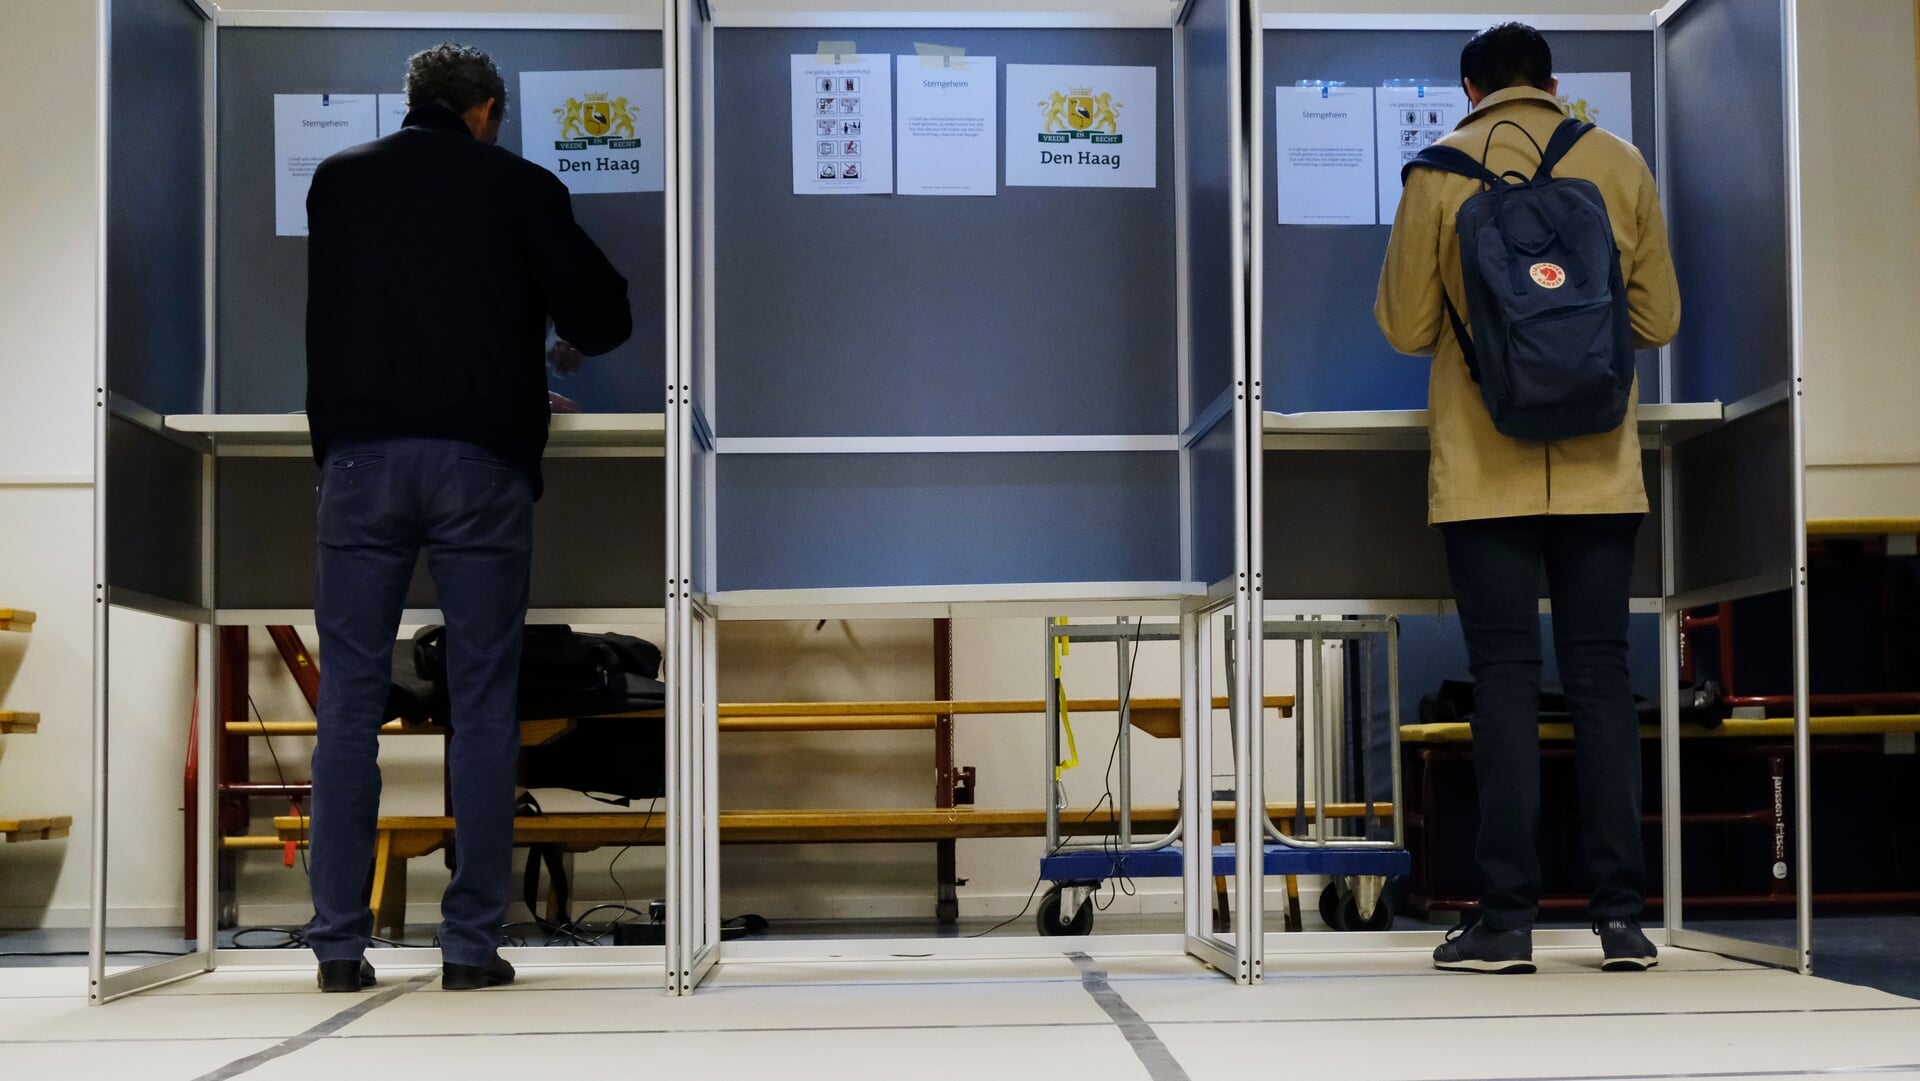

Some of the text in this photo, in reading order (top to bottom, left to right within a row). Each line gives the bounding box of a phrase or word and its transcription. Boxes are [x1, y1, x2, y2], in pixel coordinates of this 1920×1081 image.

[922, 80, 969, 89] Stemgeheim
[1302, 111, 1347, 120] Stemgeheim
[301, 119, 349, 128] Stemgeheim
[1040, 150, 1120, 169] Den Haag
[558, 157, 640, 174] Den Haag
